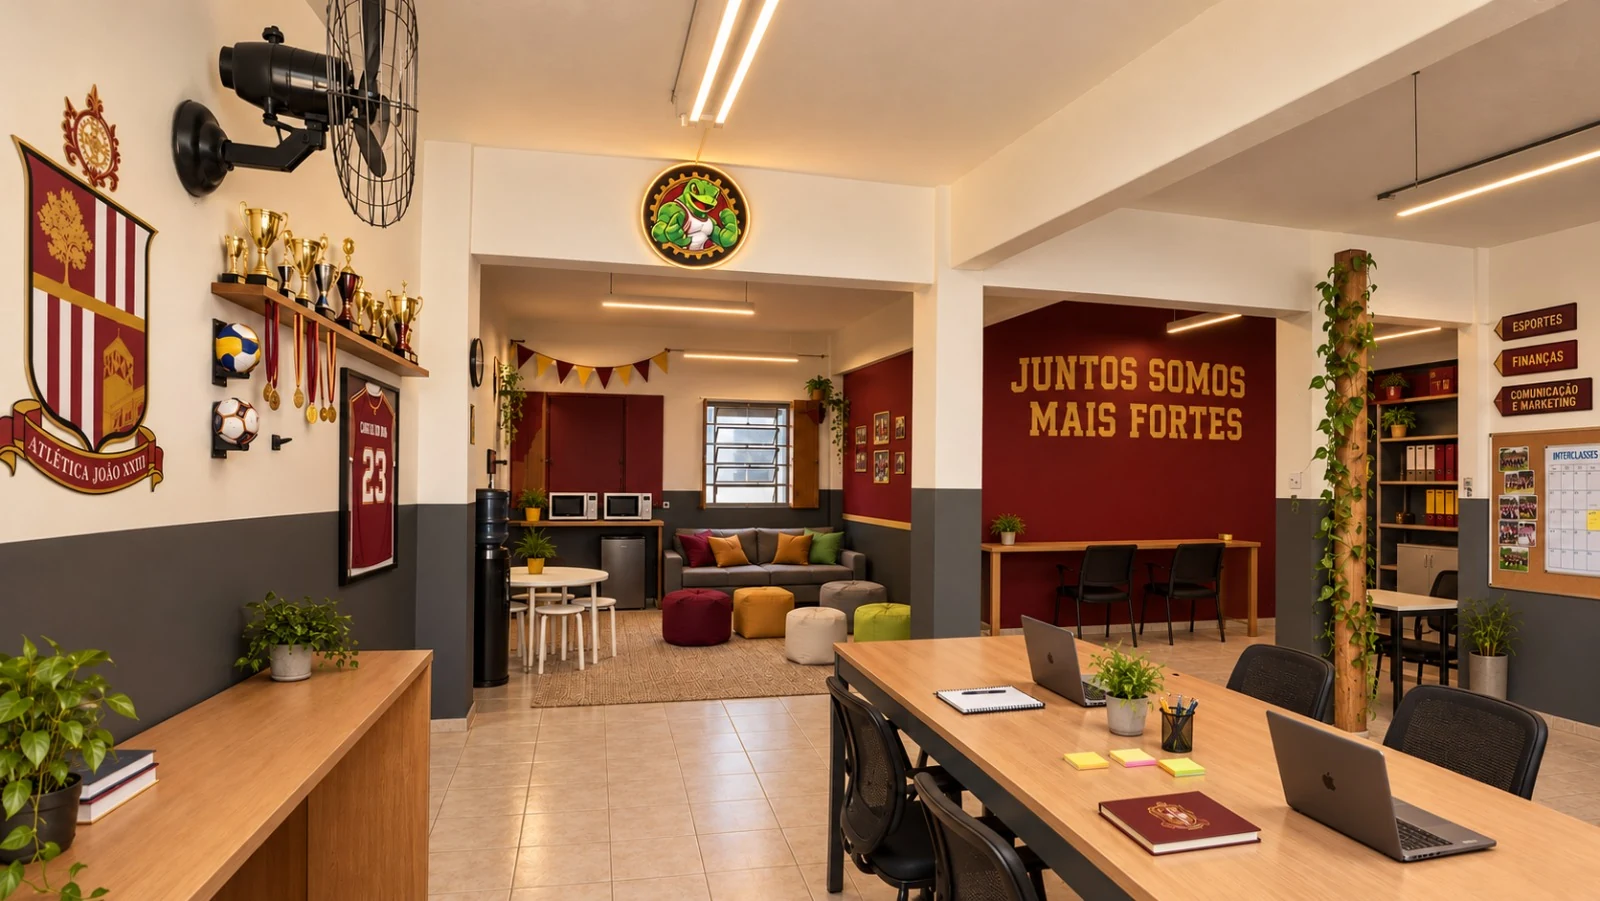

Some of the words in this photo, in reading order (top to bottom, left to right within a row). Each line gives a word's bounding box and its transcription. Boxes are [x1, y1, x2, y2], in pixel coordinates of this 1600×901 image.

[1513, 314, 1563, 332] ESPORTES
[1513, 350, 1564, 367] FINANÇAS
[1011, 355, 1138, 393] JUNTOS
[1149, 358, 1246, 398] SOMOS
[1511, 383, 1579, 400] COMUNICAÇÃO
[1512, 401, 1518, 411] E
[1520, 397, 1576, 411] MARKETING
[1029, 401, 1117, 438] MAIS
[1129, 403, 1243, 441] FORTES
[28, 436, 89, 481] ATLÉTICA
[122, 455, 146, 477] XXIII
[1552, 451, 1599, 460] INTERCLASSES
[362, 447, 387, 504] 23
